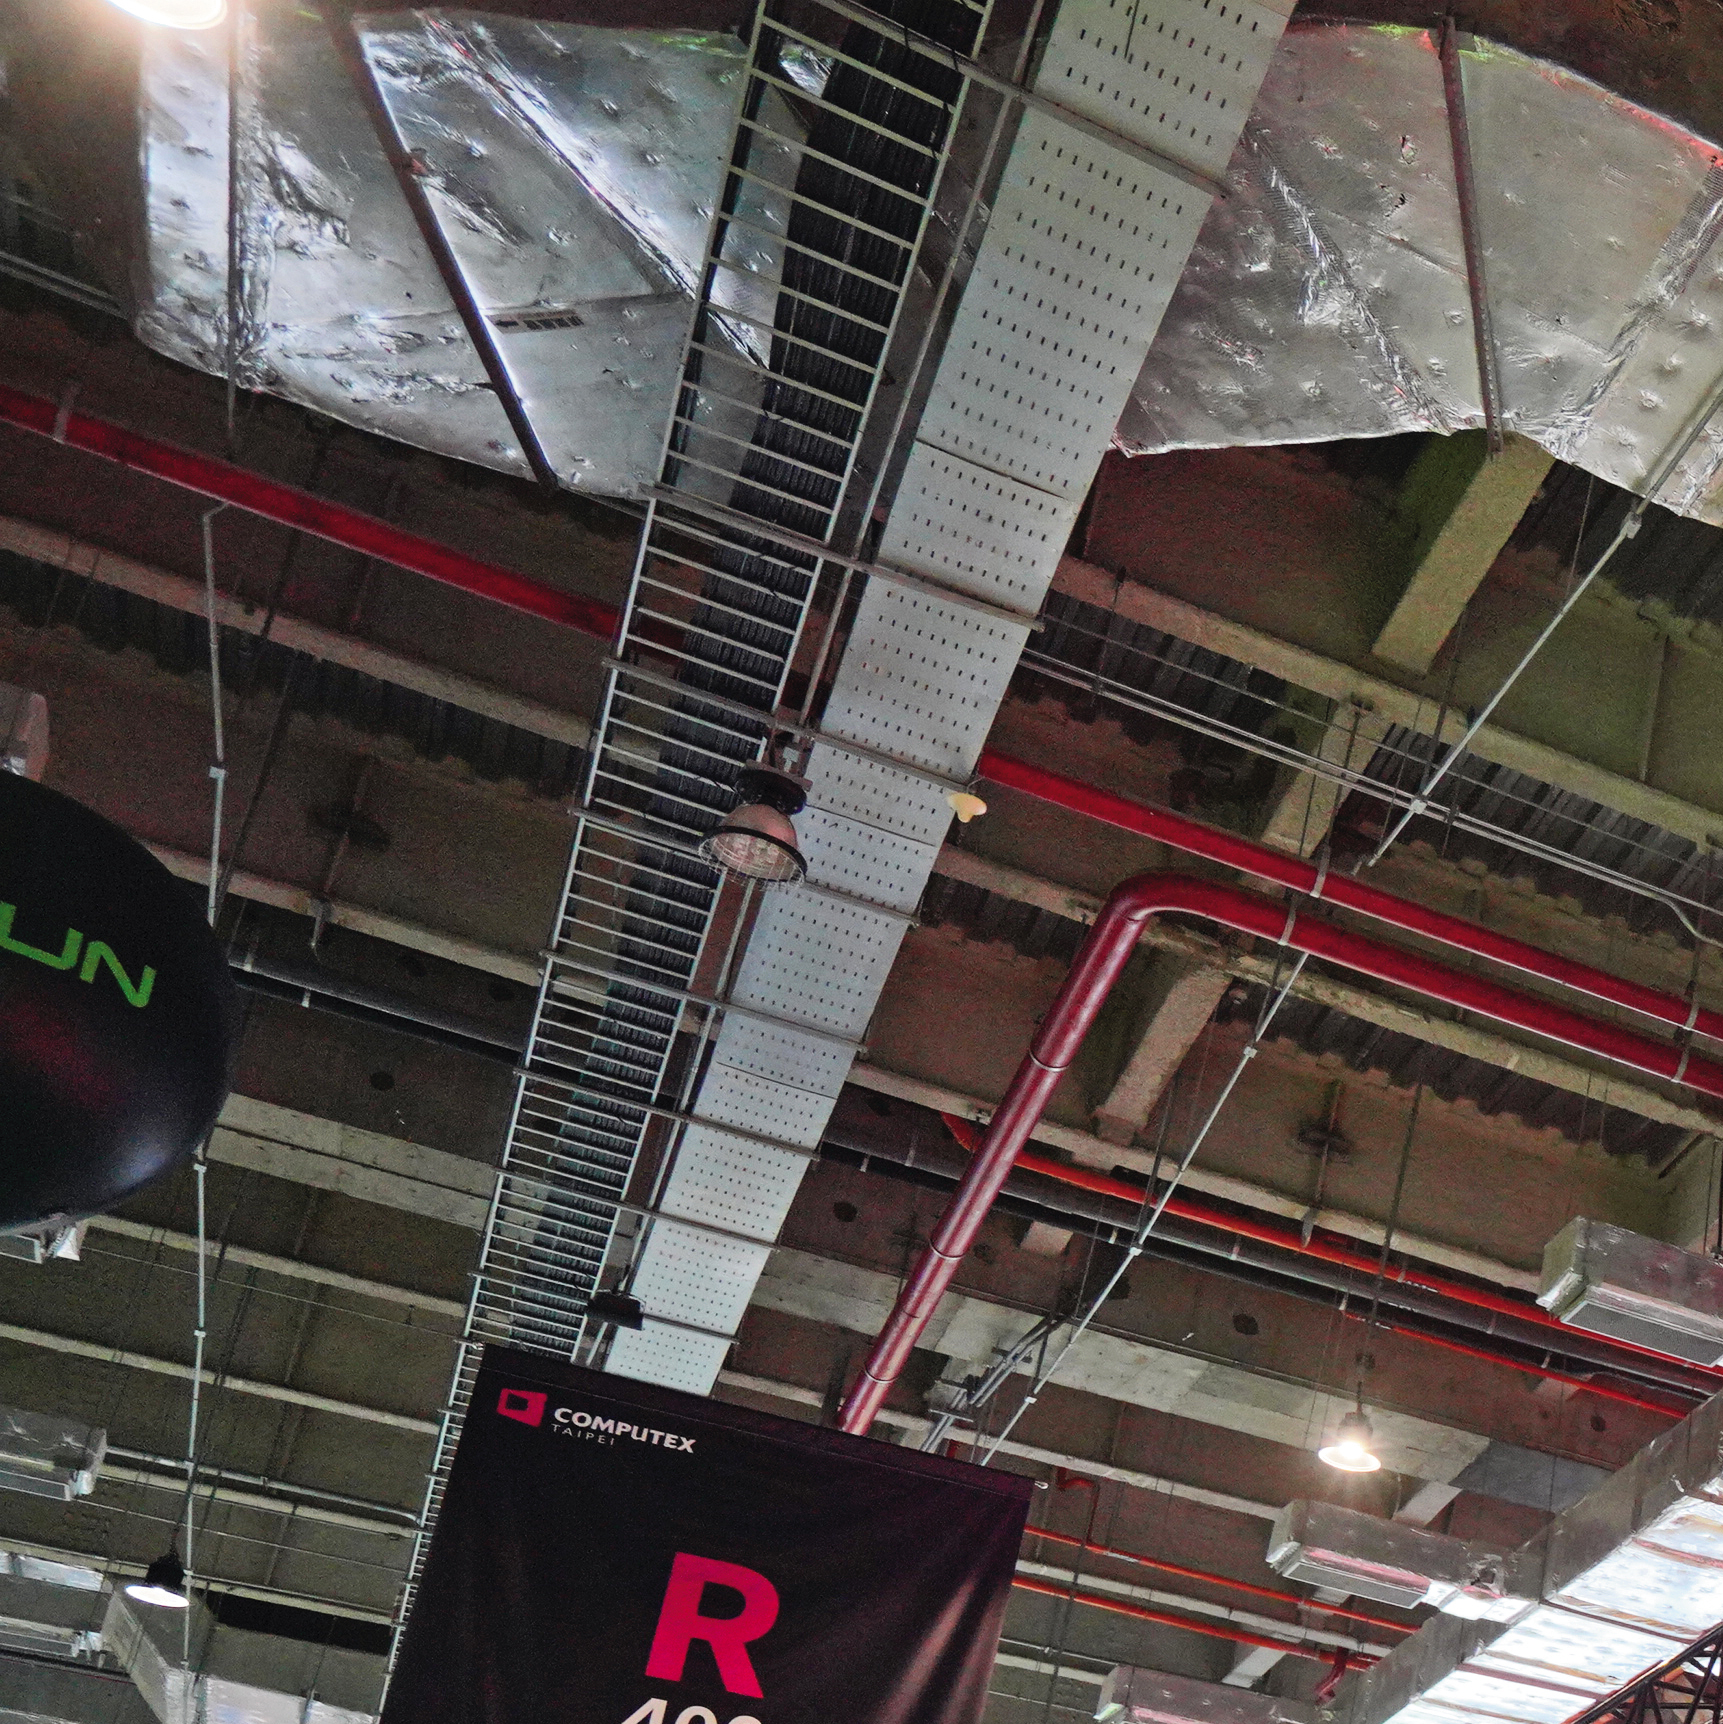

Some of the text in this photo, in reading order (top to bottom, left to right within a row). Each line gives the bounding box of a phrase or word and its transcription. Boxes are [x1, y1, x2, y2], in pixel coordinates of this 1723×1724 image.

[552, 1423, 615, 1446] TAIPEI
[554, 1407, 697, 1453] COMPUTEX
[644, 1551, 780, 1699] R
